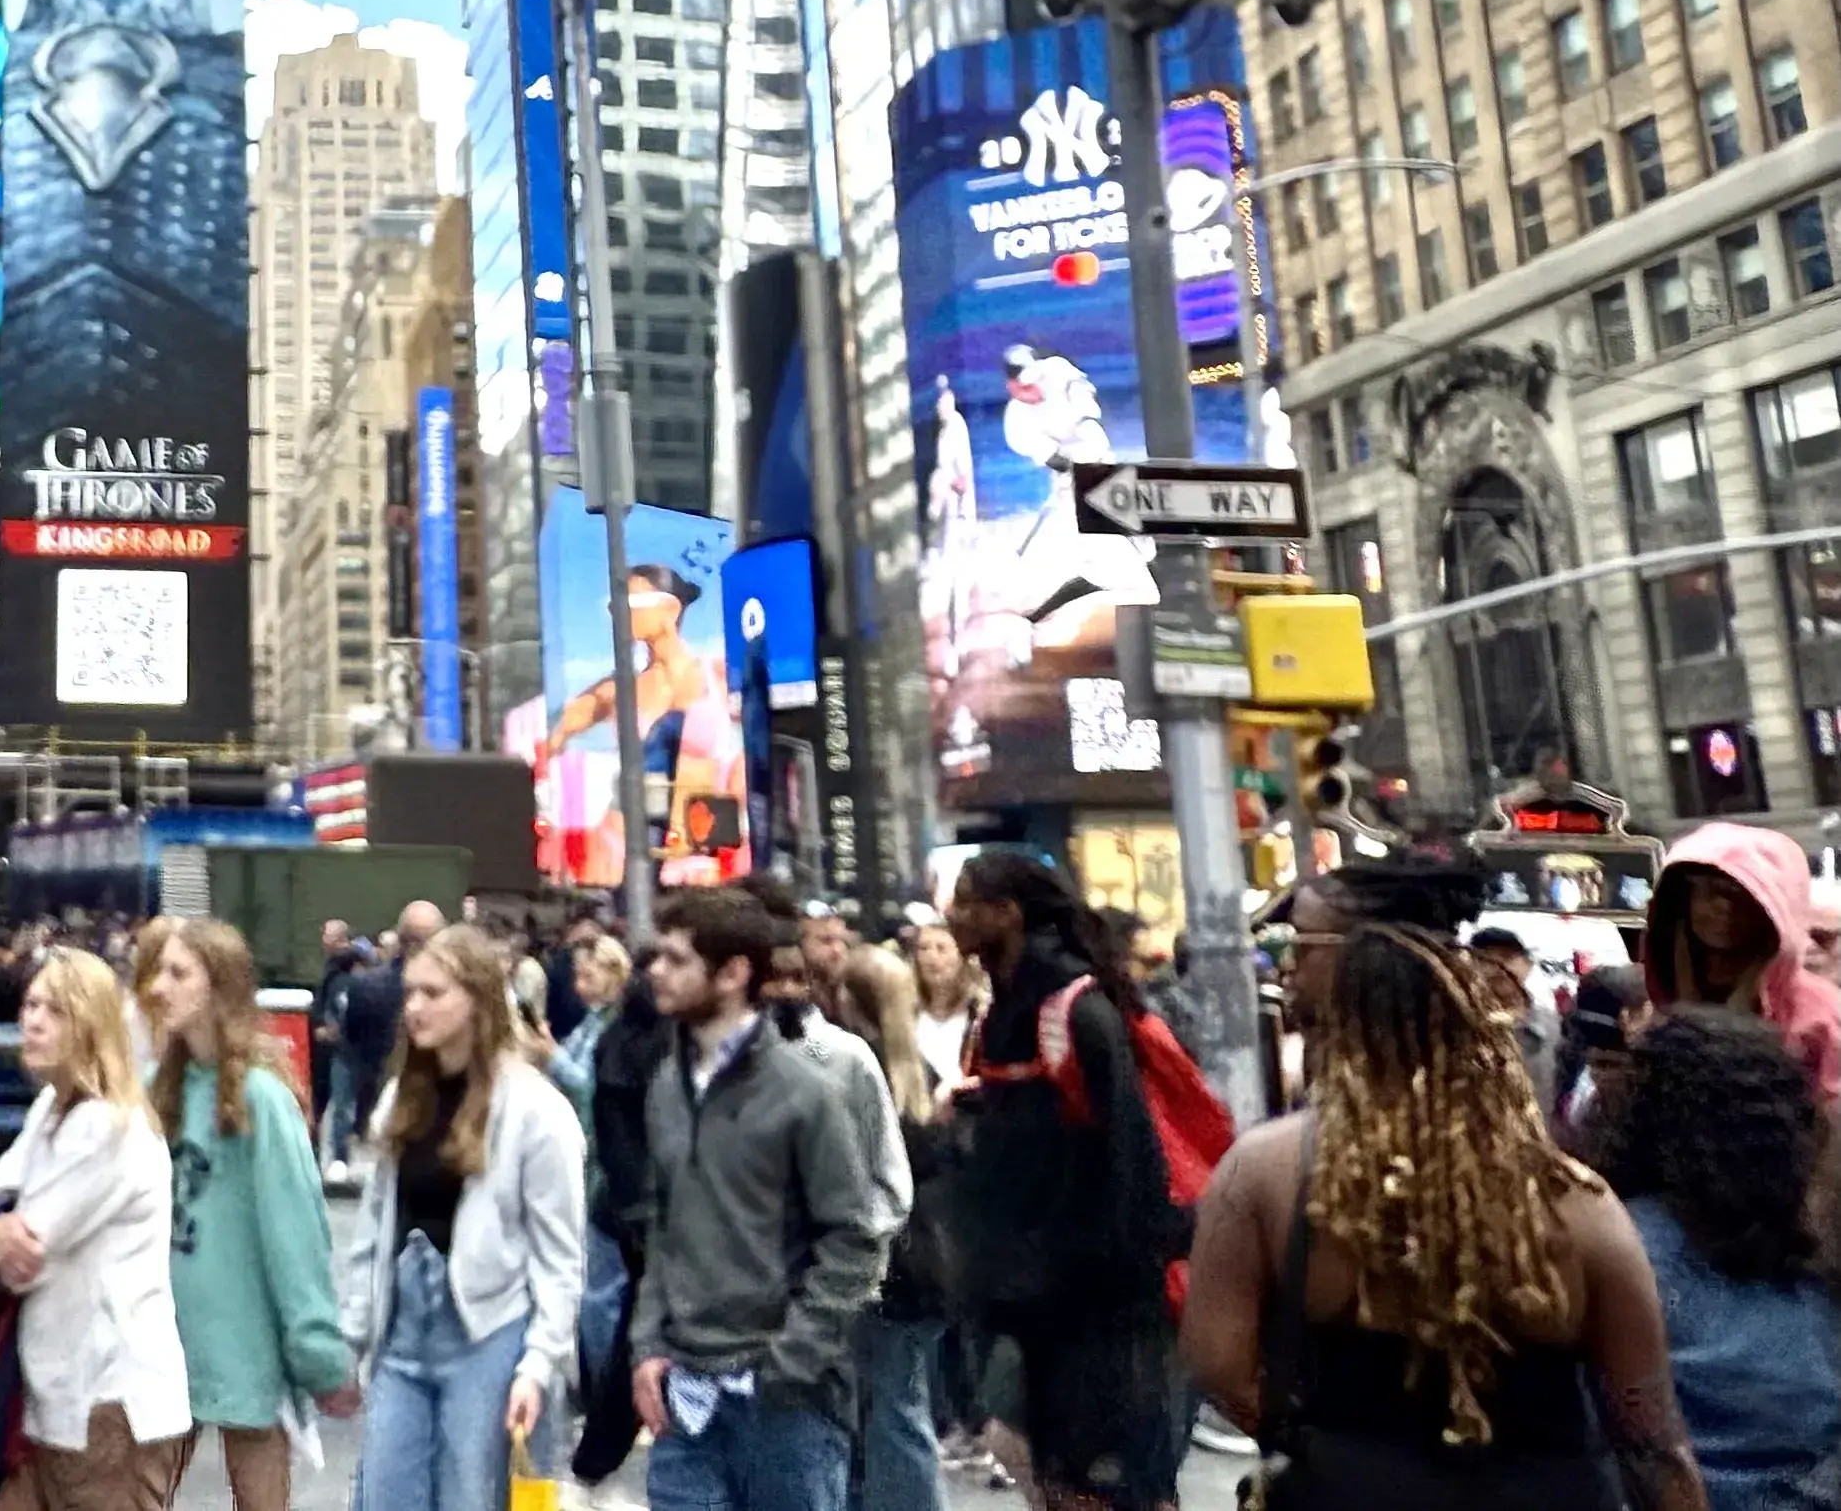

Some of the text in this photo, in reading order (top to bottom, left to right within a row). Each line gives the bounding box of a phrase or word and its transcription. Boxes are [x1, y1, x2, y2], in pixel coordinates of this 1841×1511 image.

[1052, 212, 1129, 252] TICKE
[42, 427, 174, 471] GAME
[24, 469, 225, 522] THRONES
[1110, 483, 1277, 514] ONE WAY
[36, 524, 212, 557] KINGSROAD
